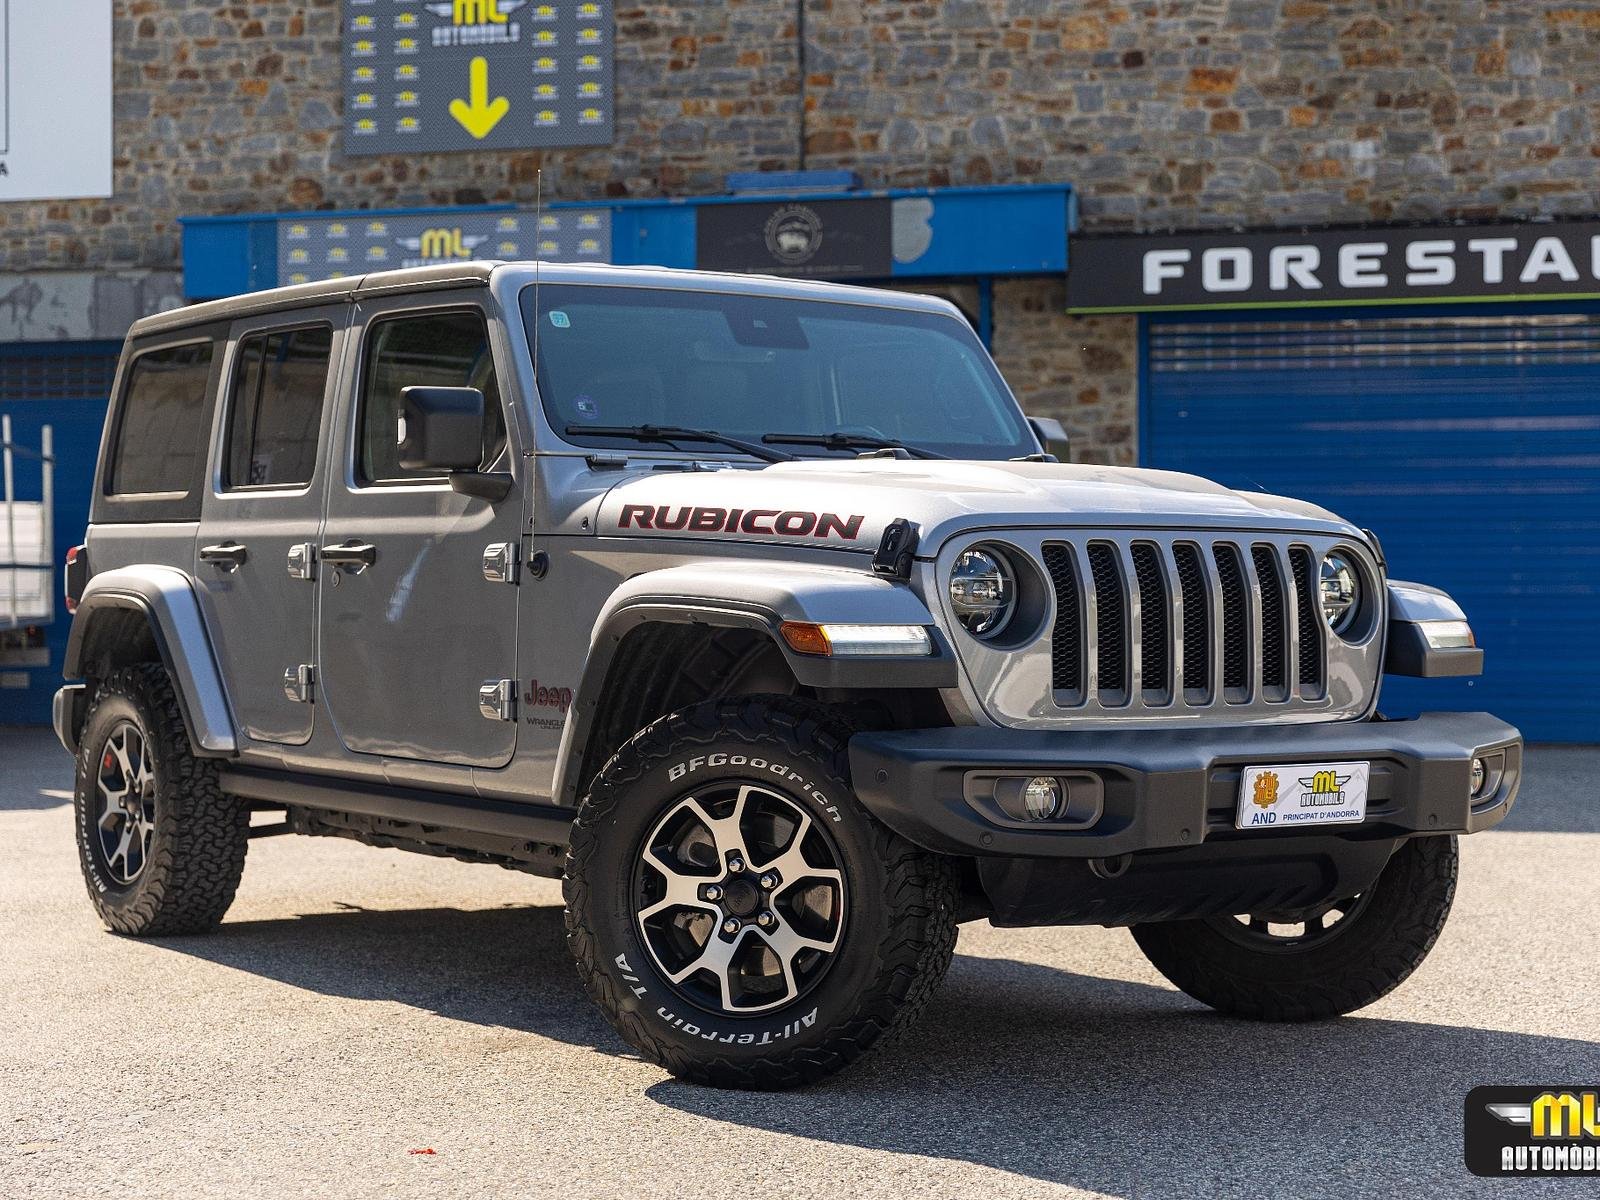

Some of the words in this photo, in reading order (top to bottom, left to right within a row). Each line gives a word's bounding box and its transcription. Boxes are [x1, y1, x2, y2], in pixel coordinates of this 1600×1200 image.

[421, 227, 472, 257] ML
[1142, 234, 1600, 295] FORESTA
[618, 504, 865, 540] RUBICON
[524, 679, 572, 713] Jeep
[668, 753, 842, 823] BFGoodrich
[1312, 770, 1340, 793] ML
[1251, 812, 1277, 825] AND
[1282, 812, 1318, 821] PRINCIPAT
[1320, 810, 1360, 819] D'ANDORRA
[614, 952, 648, 1000] T/A
[656, 1006, 819, 1046] All-Terrain
